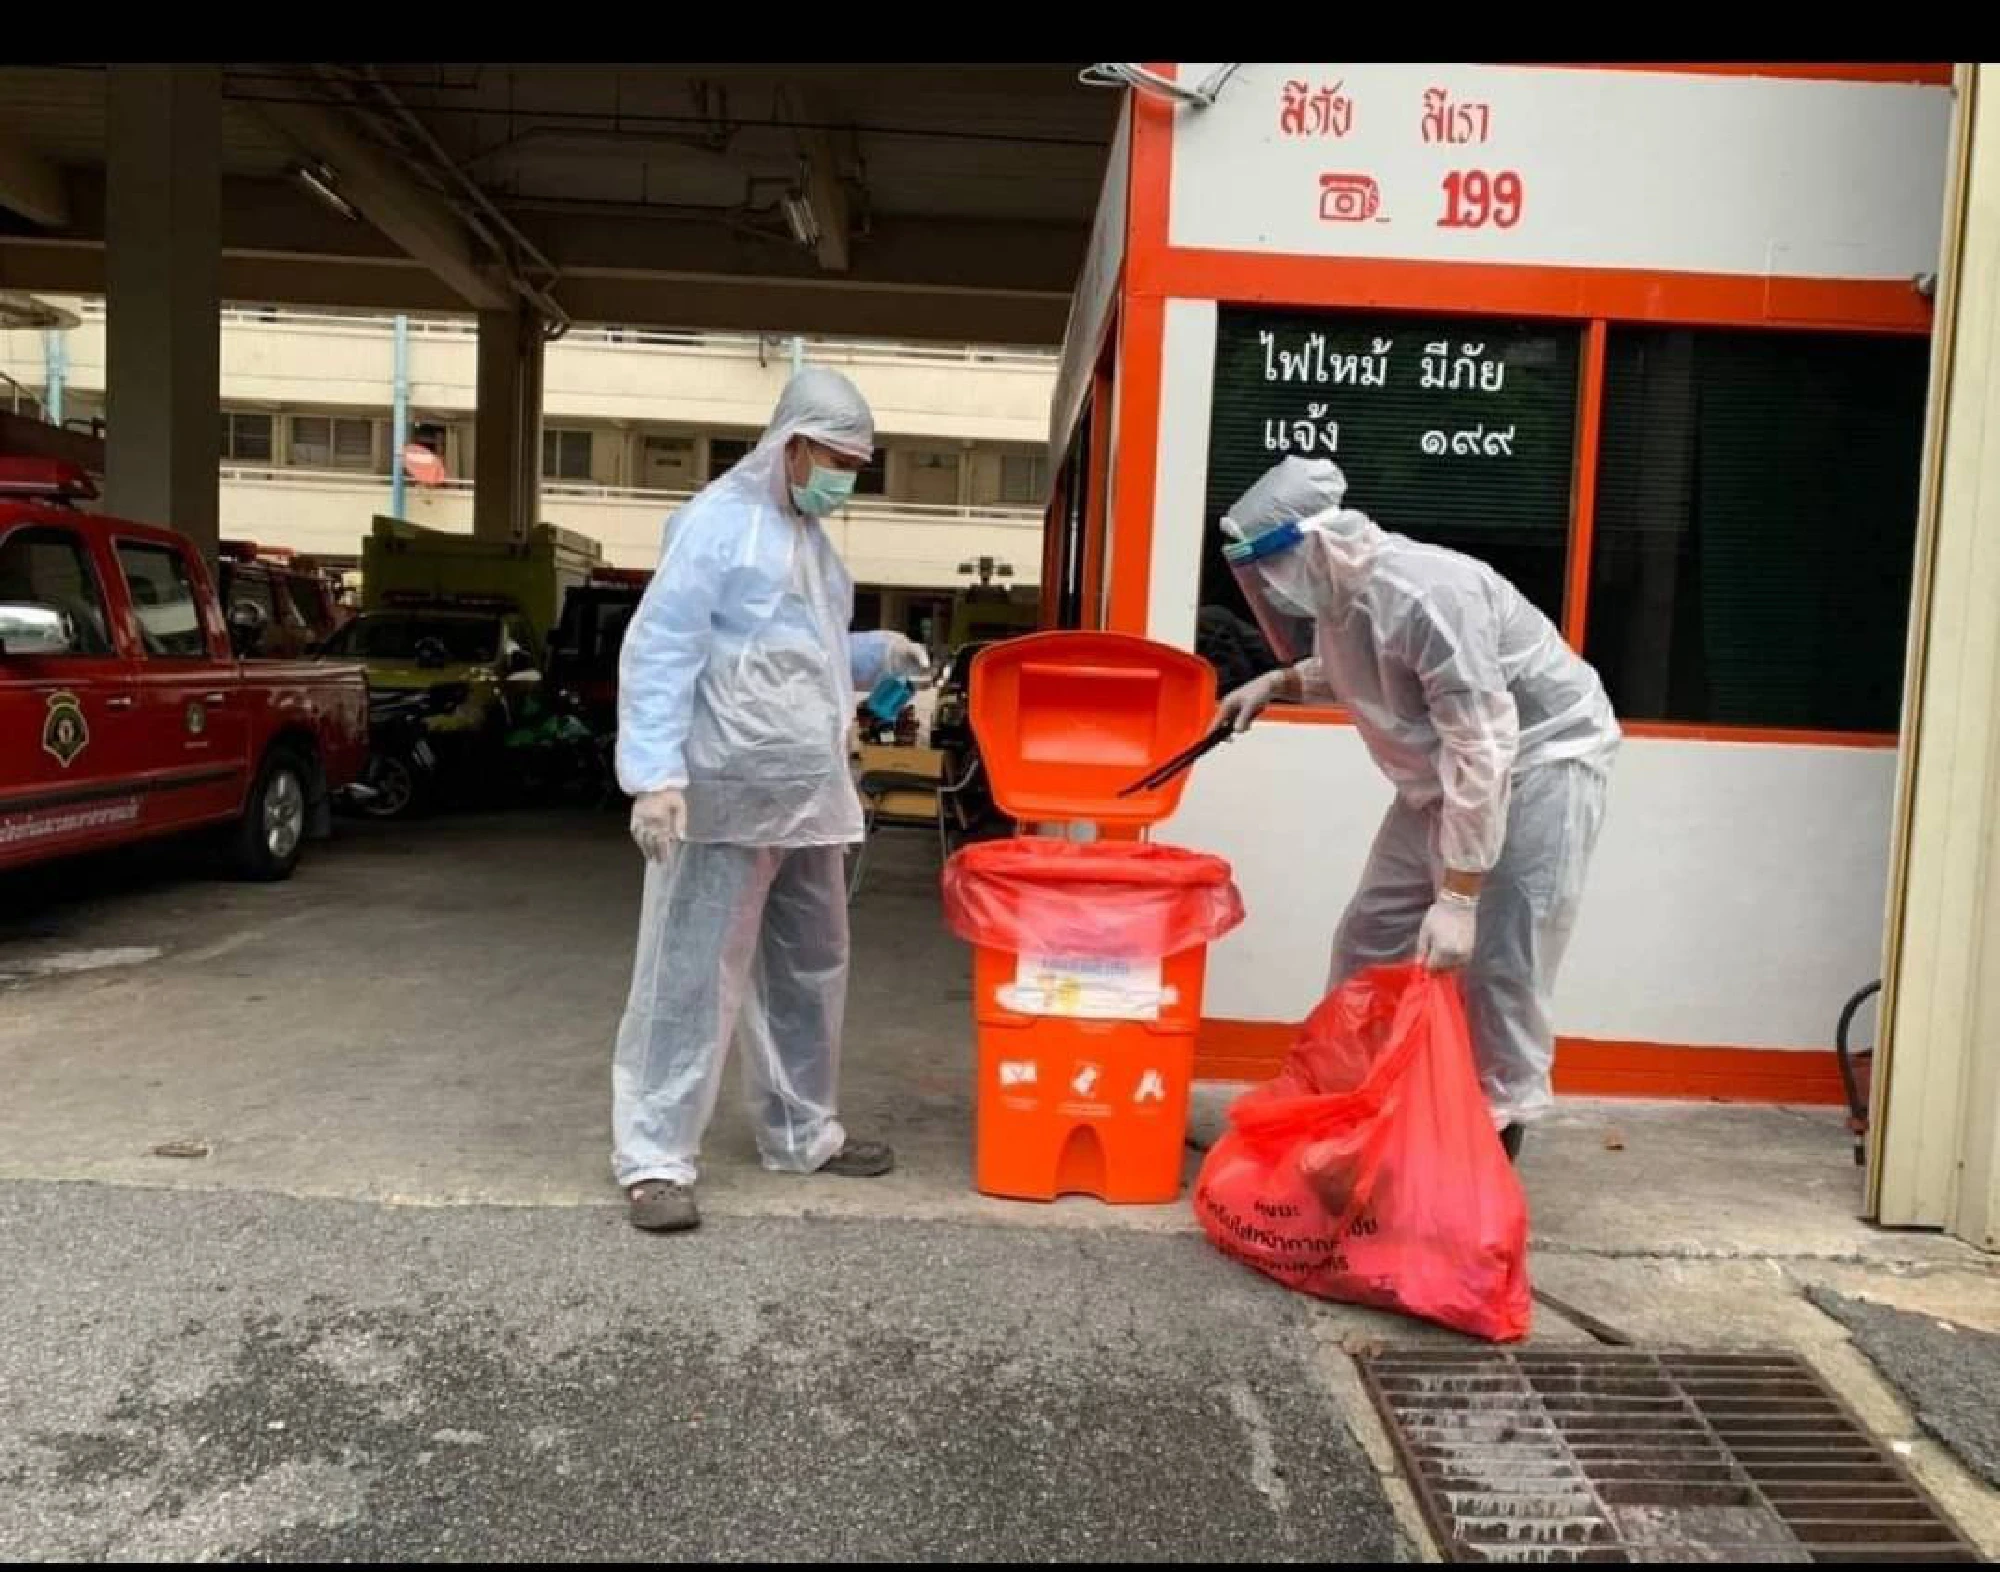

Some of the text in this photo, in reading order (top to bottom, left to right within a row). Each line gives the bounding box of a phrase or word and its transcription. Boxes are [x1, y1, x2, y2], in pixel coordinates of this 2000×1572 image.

[1437, 170, 1523, 229] 199
[1260, 331, 1505, 391] ไฟไหม้ มีภัย
[1264, 403, 1515, 456] แจ้ง ๑๙๙
